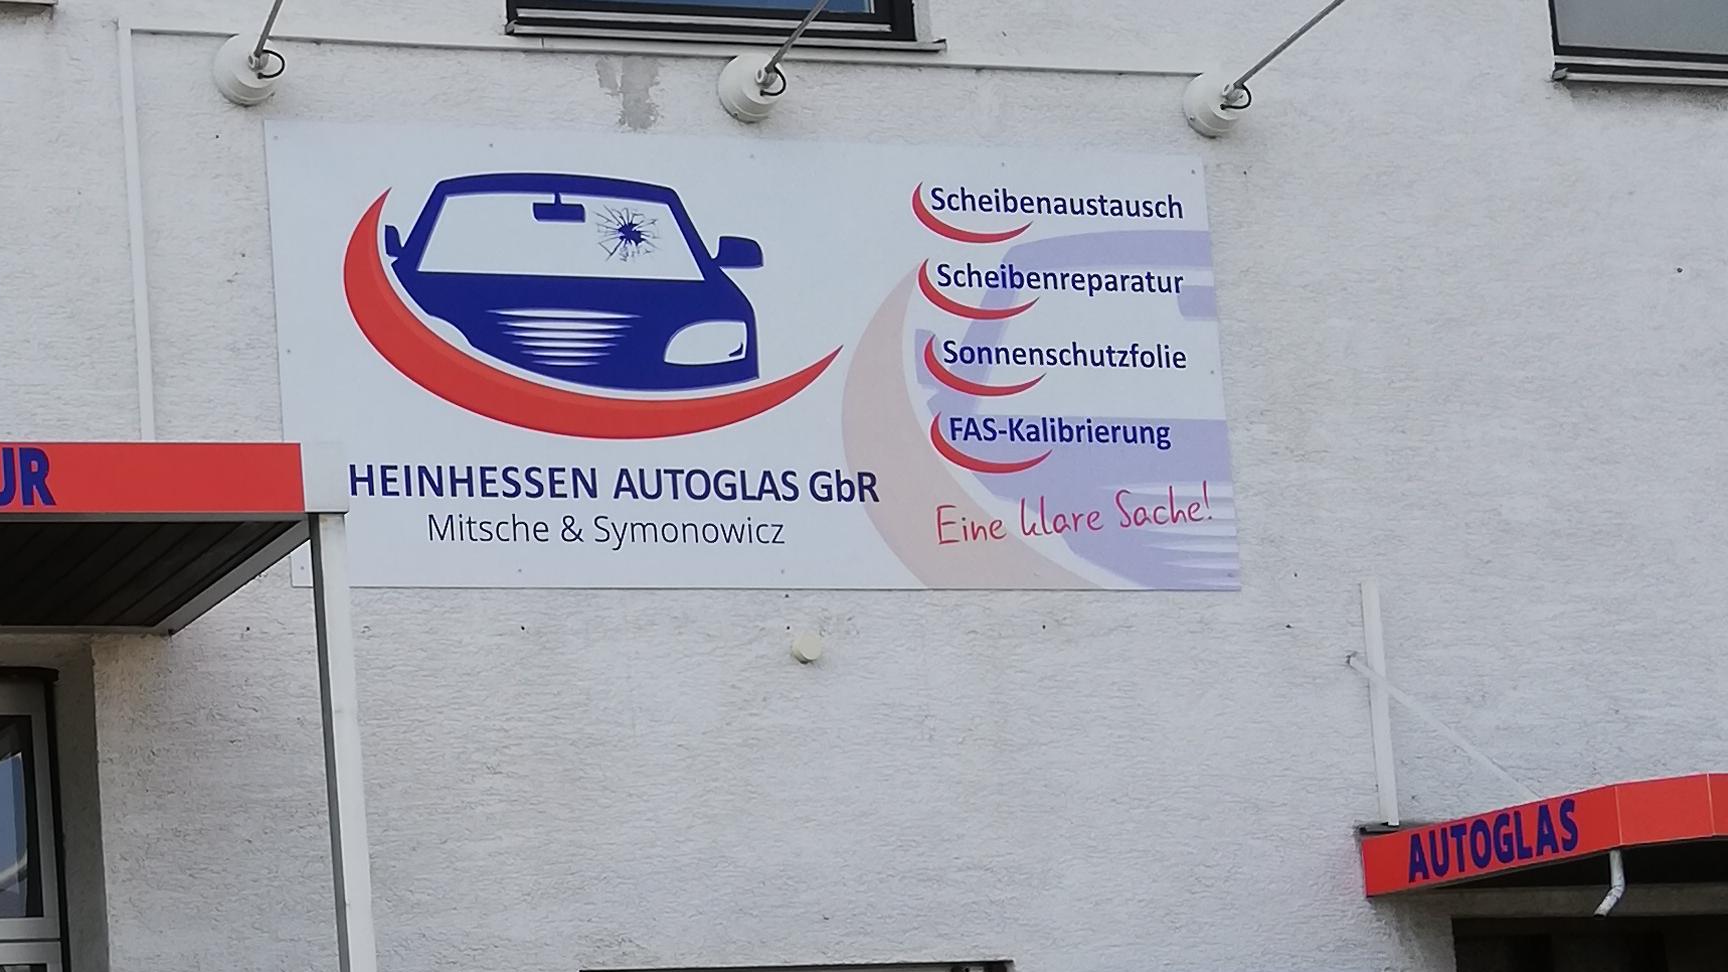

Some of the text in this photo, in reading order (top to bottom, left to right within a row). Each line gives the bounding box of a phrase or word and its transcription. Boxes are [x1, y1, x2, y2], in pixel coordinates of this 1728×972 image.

[930, 187, 1184, 219] Scheibenaustausch
[936, 264, 1184, 296] Scheibenreparatur
[943, 340, 1187, 369] Sonnenschutzfolie
[950, 417, 1172, 450] FAS-Kalibrierung
[349, 464, 881, 504] HEINHESSEN AUTOGLAS GbR
[935, 480, 1214, 545] Eine klare Sache!
[427, 513, 786, 551] Mitsche & Symonowicz
[1409, 799, 1579, 883] AUTOGLAS
